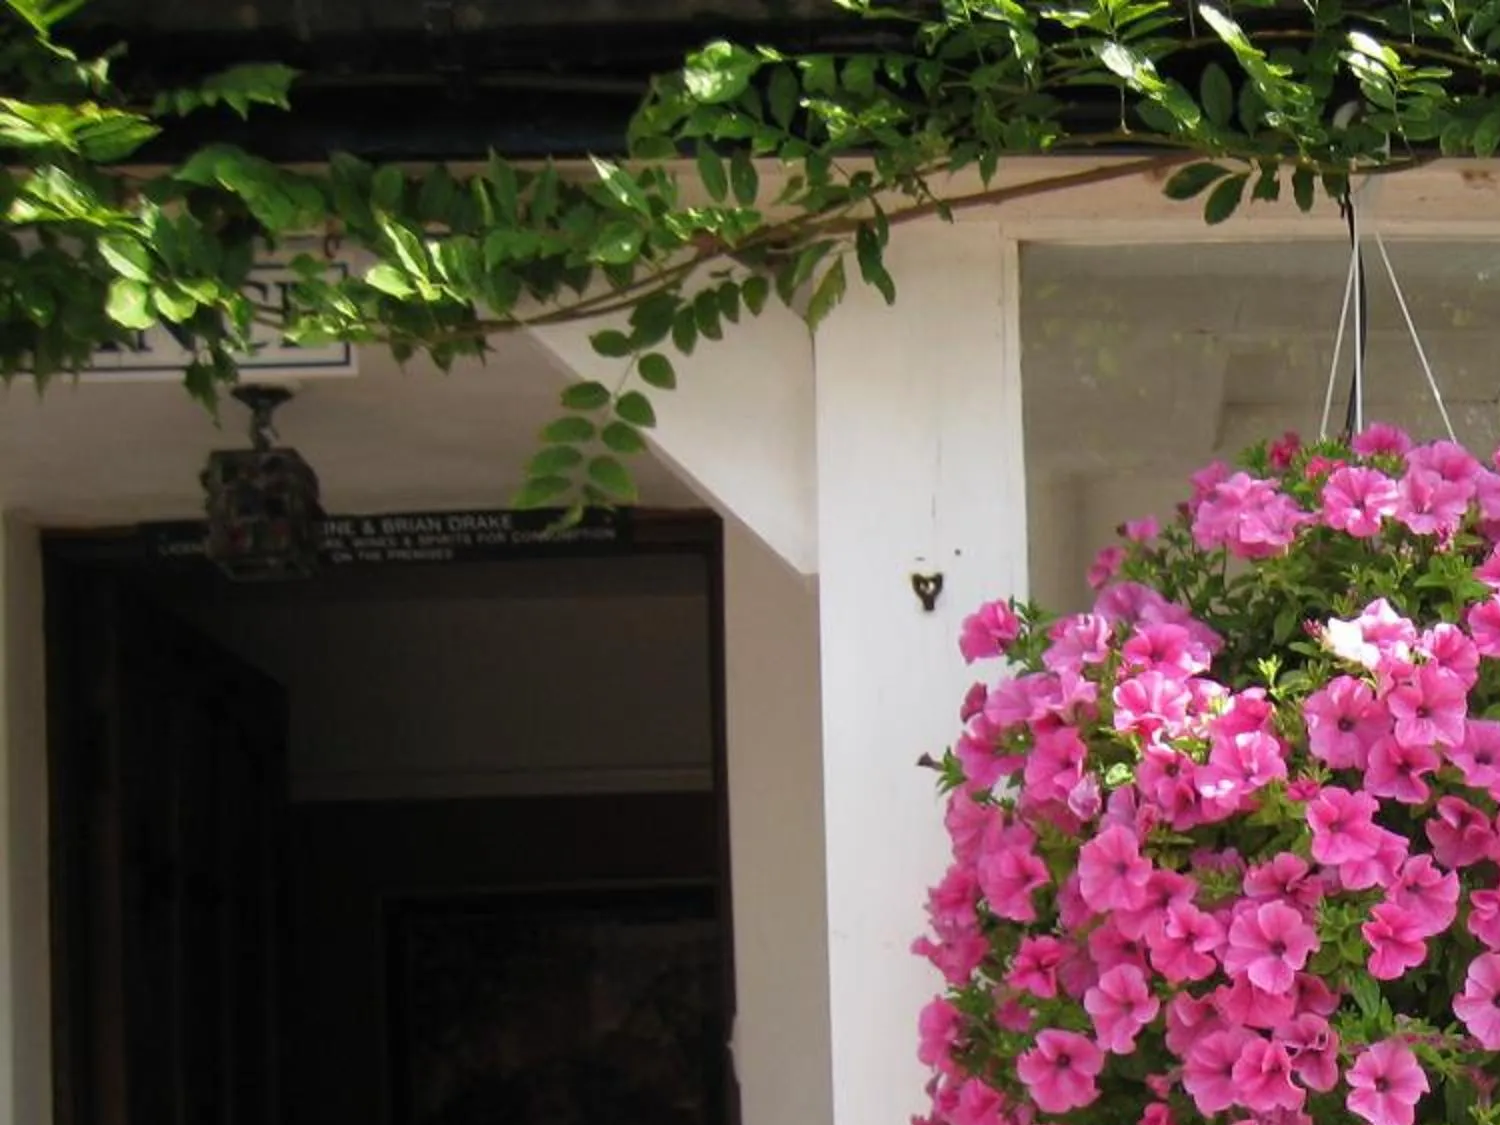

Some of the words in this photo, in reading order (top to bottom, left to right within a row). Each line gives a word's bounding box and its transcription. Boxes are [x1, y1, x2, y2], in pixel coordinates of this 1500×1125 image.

[362, 519, 375, 535] &
[381, 516, 442, 533] BRIAN
[447, 512, 512, 531] DRAKE
[476, 531, 506, 544] FOR
